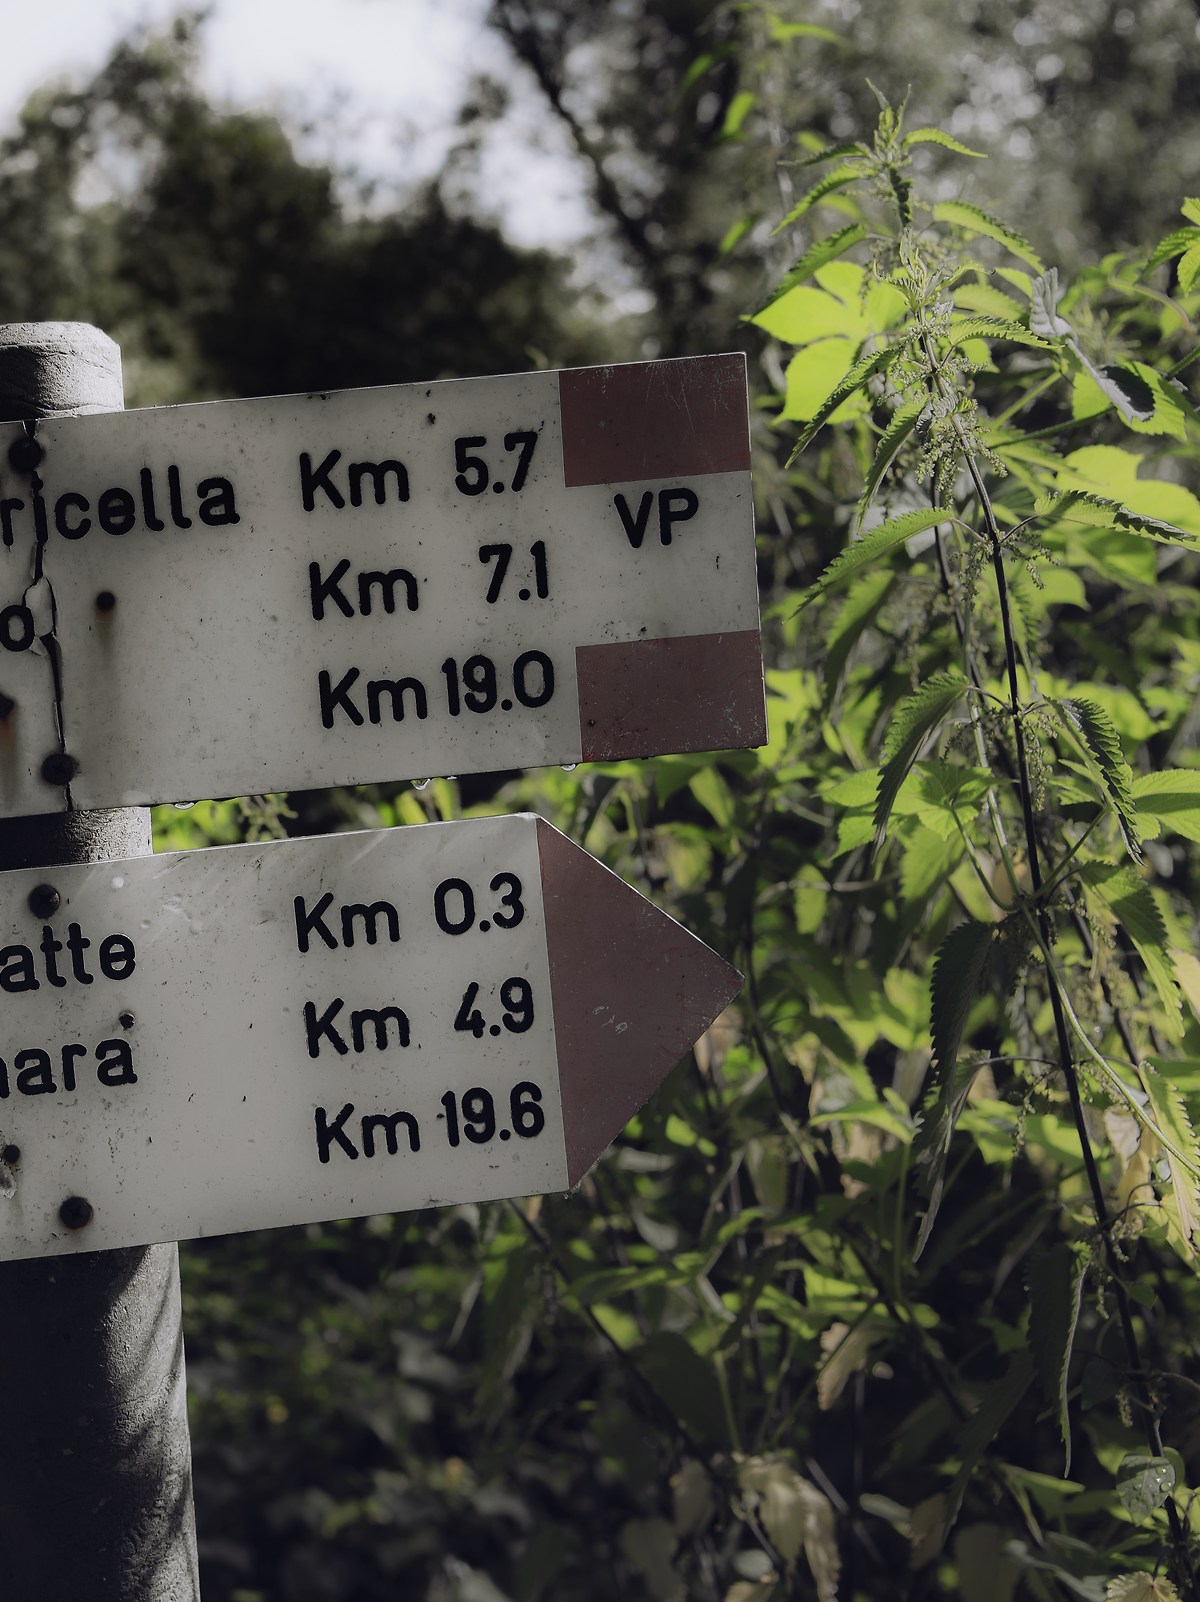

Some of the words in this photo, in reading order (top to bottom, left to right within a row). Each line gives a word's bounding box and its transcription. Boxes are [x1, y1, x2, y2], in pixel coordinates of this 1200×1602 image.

[299, 449, 410, 511] Km
[454, 431, 538, 496] 5.7
[614, 487, 698, 548] VP
[309, 558, 419, 621] Km
[479, 541, 549, 604] 7.1
[319, 667, 428, 729] Km
[441, 650, 555, 716] 19.0
[294, 893, 401, 952] Km
[433, 872, 524, 935] 0.3
[303, 998, 409, 1058] Km
[454, 976, 534, 1038] 4.9
[315, 1103, 420, 1163] Km
[441, 1081, 545, 1146] 19.6
